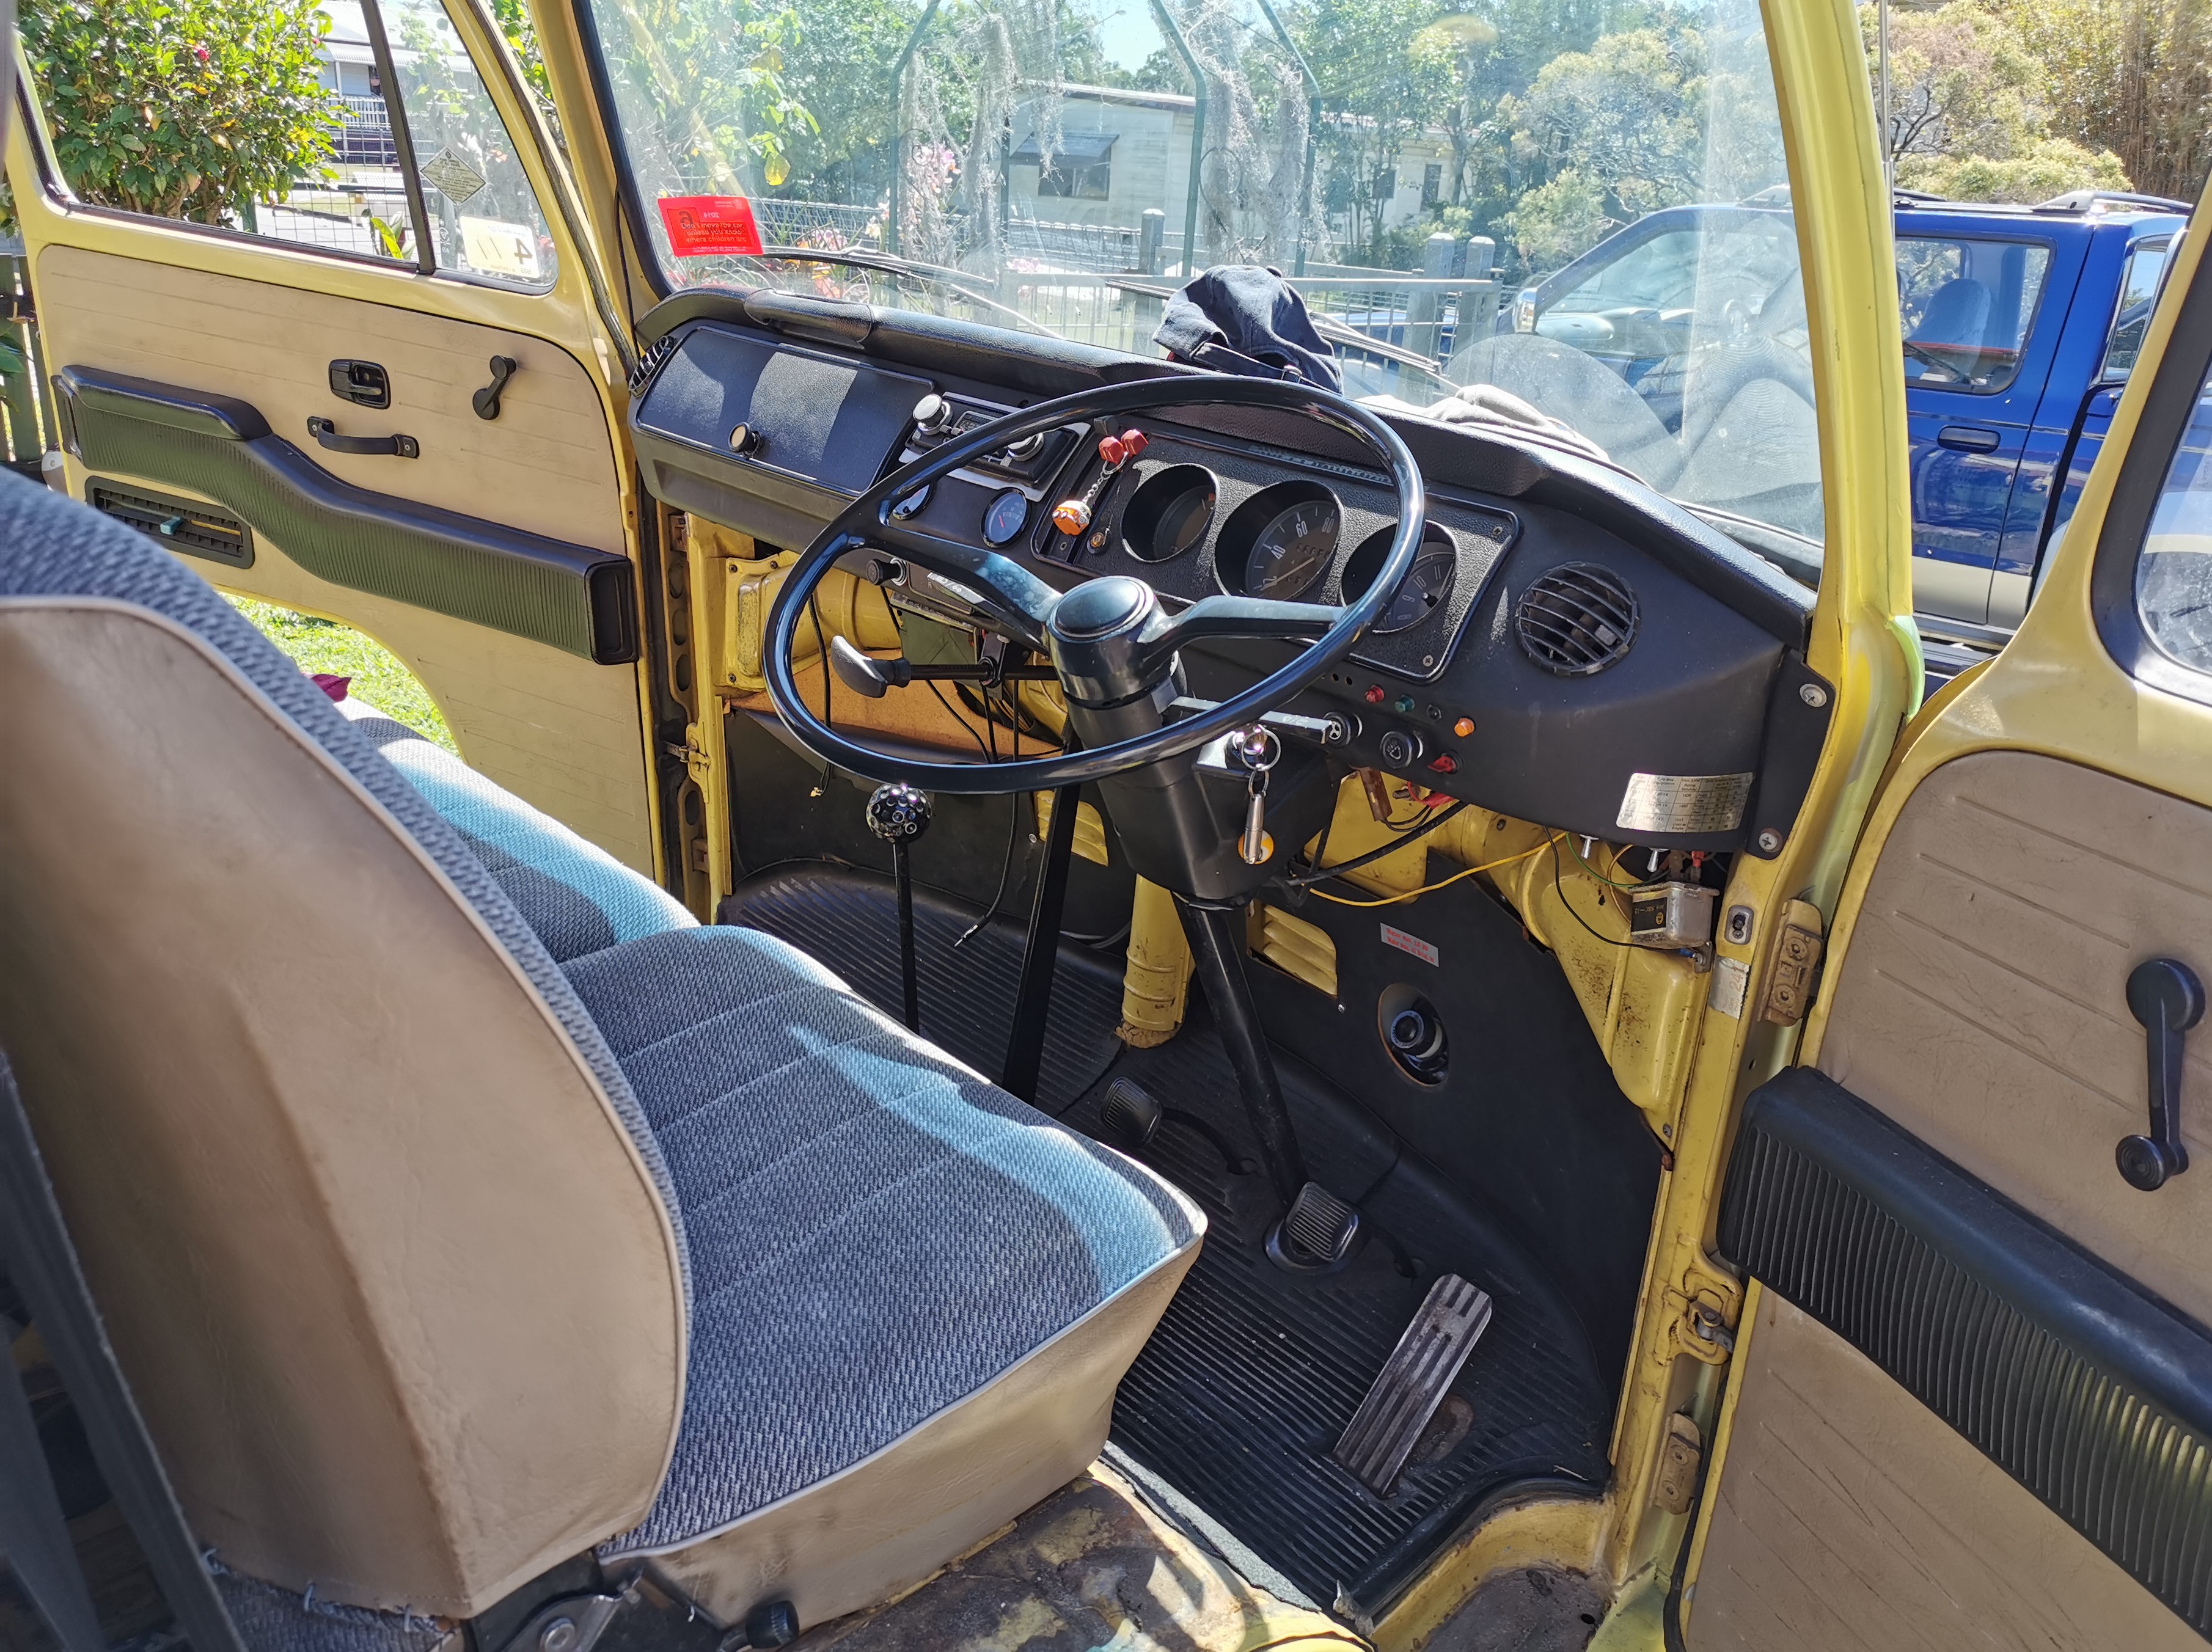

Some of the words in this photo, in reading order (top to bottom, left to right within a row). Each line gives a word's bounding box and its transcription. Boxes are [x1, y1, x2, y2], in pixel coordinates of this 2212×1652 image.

[1295, 521, 1308, 538] 60
[1322, 517, 1335, 533] 80
[1271, 544, 1286, 560] 40
[1434, 565, 1441, 580] 11
[1413, 575, 1427, 590] 10
